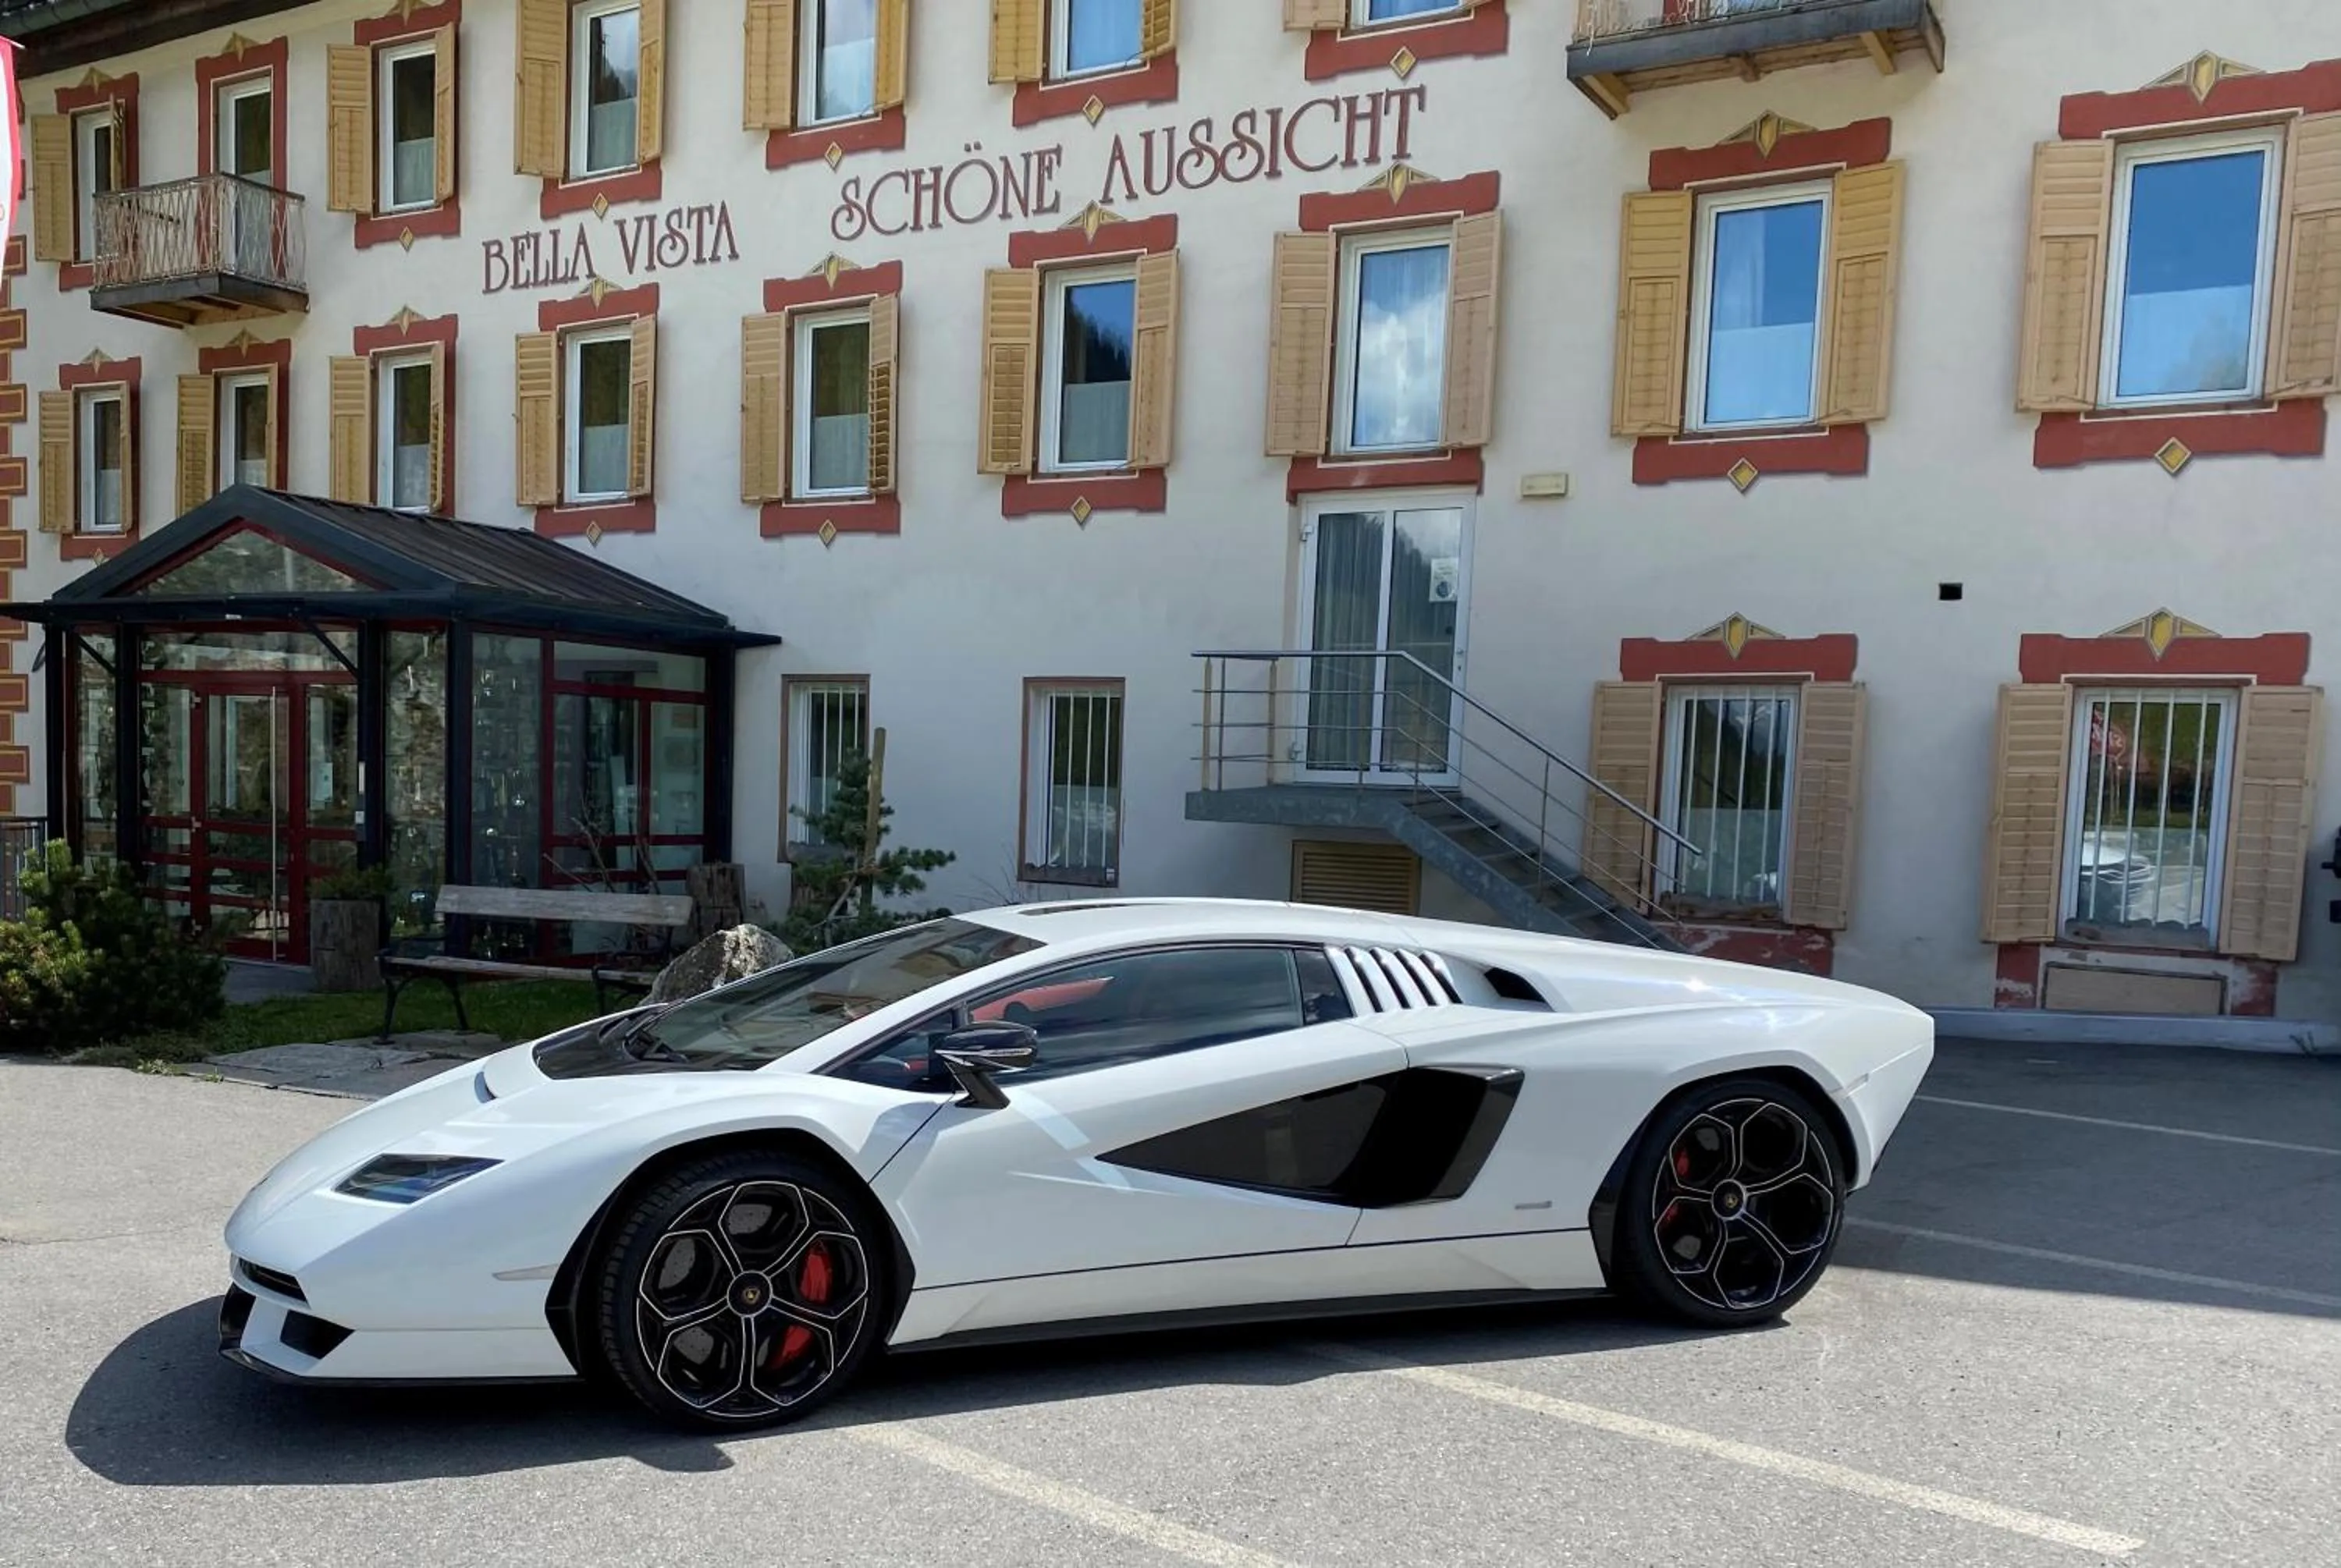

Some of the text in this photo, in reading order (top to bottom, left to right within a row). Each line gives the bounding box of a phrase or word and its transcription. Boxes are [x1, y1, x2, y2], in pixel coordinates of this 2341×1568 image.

[830, 83, 1426, 240] SCHÖNE AUSSICHT
[481, 200, 740, 294] BELLA VISTA
